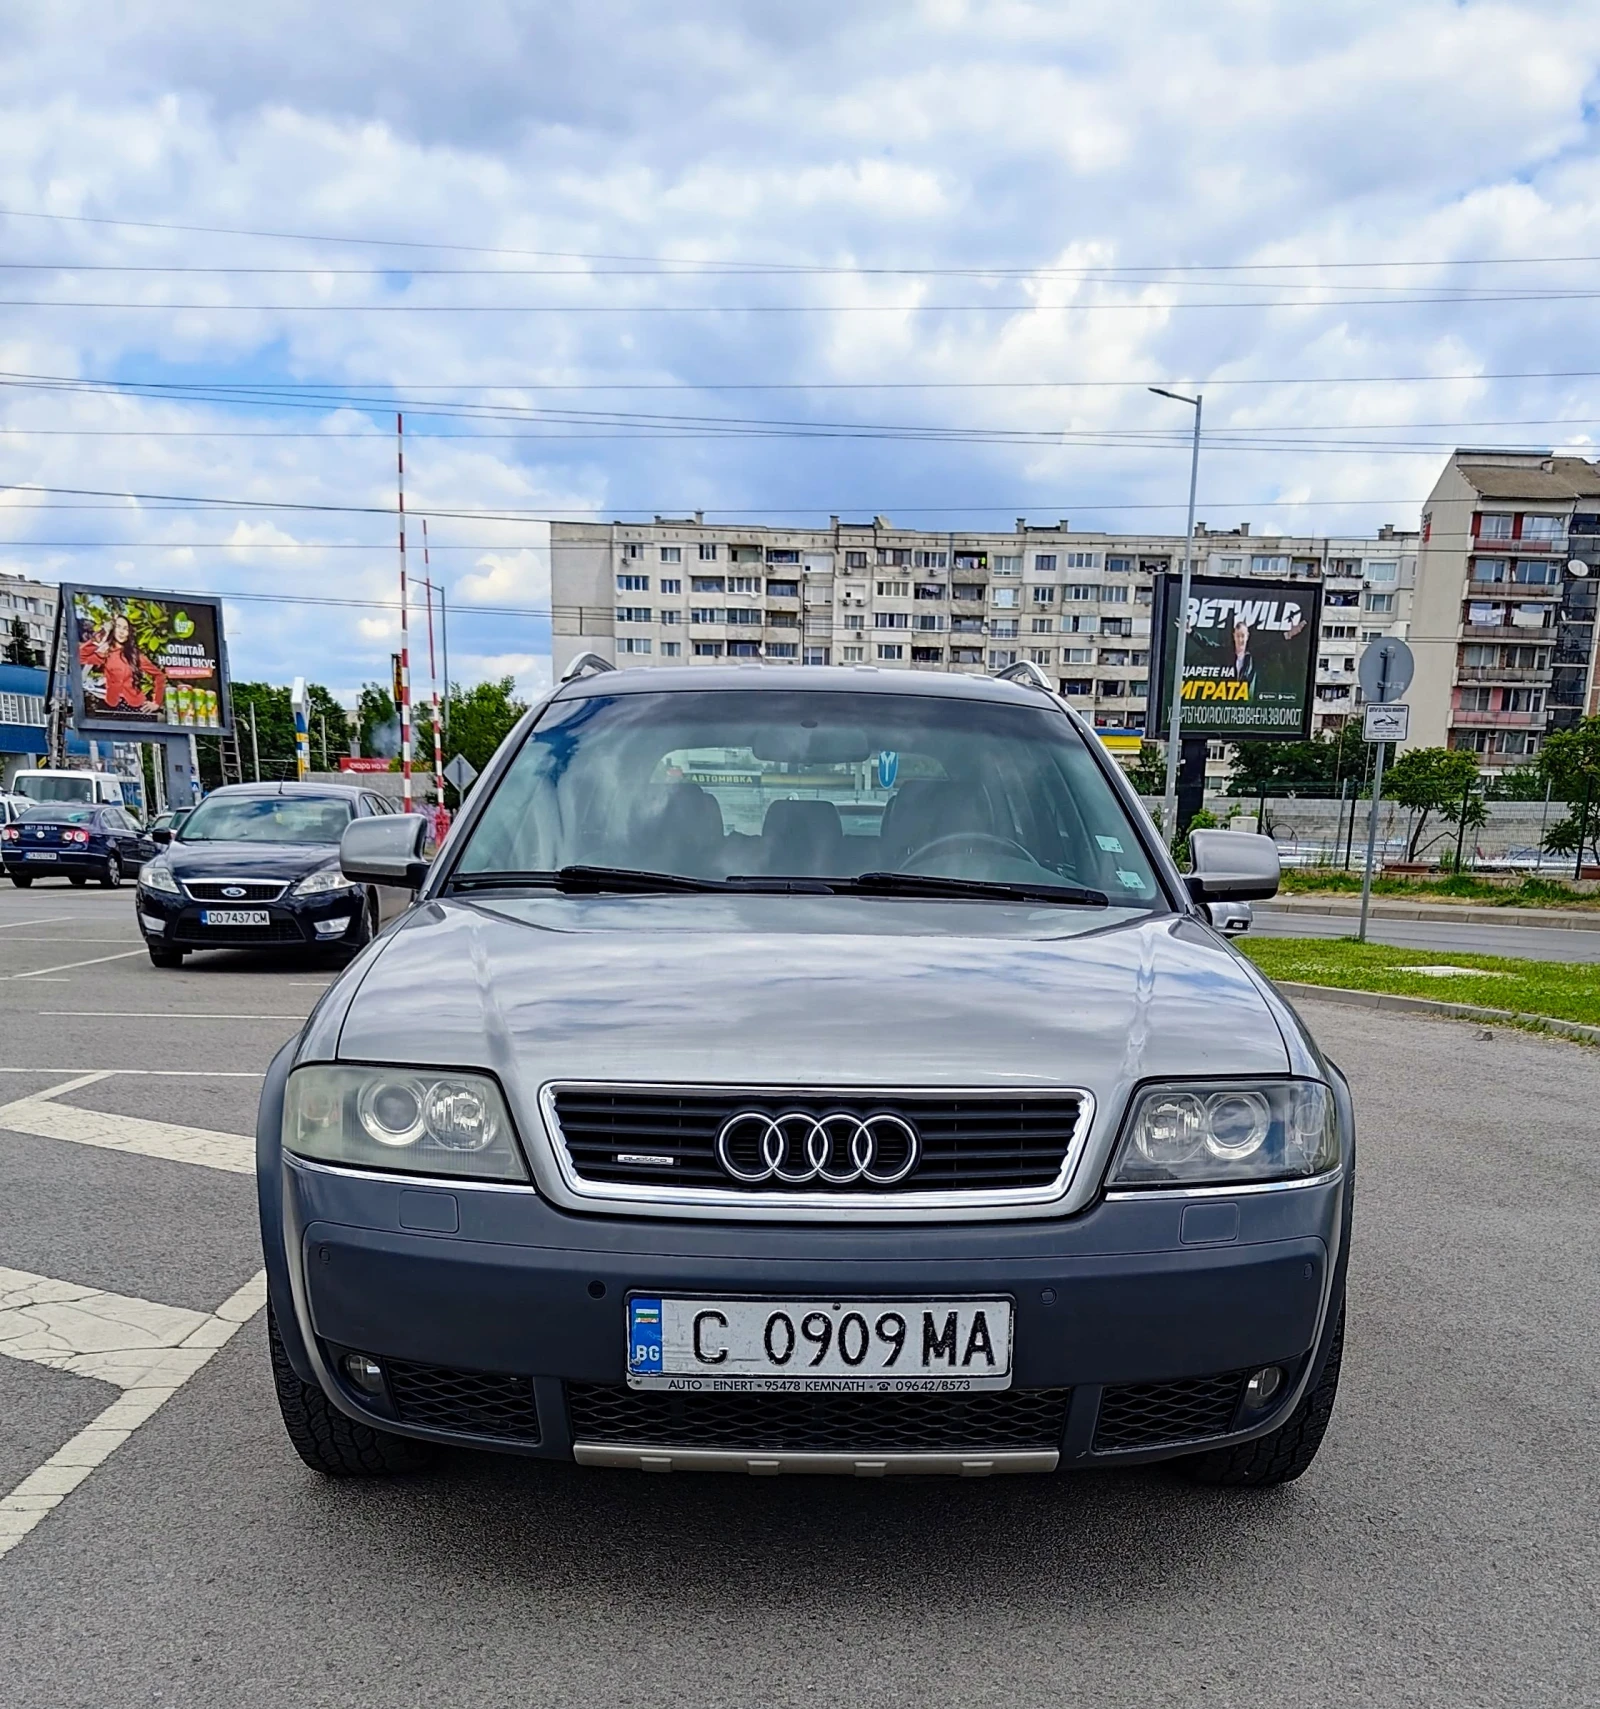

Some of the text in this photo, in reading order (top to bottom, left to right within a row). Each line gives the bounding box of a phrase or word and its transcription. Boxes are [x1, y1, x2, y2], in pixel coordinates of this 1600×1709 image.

[1186, 597, 1302, 631] BETWILD
[167, 643, 205, 657] ОПИТАЙ
[158, 655, 216, 669] НОВИЯ ВКУС
[1221, 666, 1235, 678] НА
[1179, 680, 1249, 701] ИГРАТА
[691, 774, 753, 784] АВТОМИВКА
[225, 912, 251, 924] 7437
[693, 1308, 996, 1368] C 0909 MA
[635, 1345, 660, 1362] BG
[668, 1379, 971, 1392] AUTO EINERT 95478 KEMNATH 09642/8573
